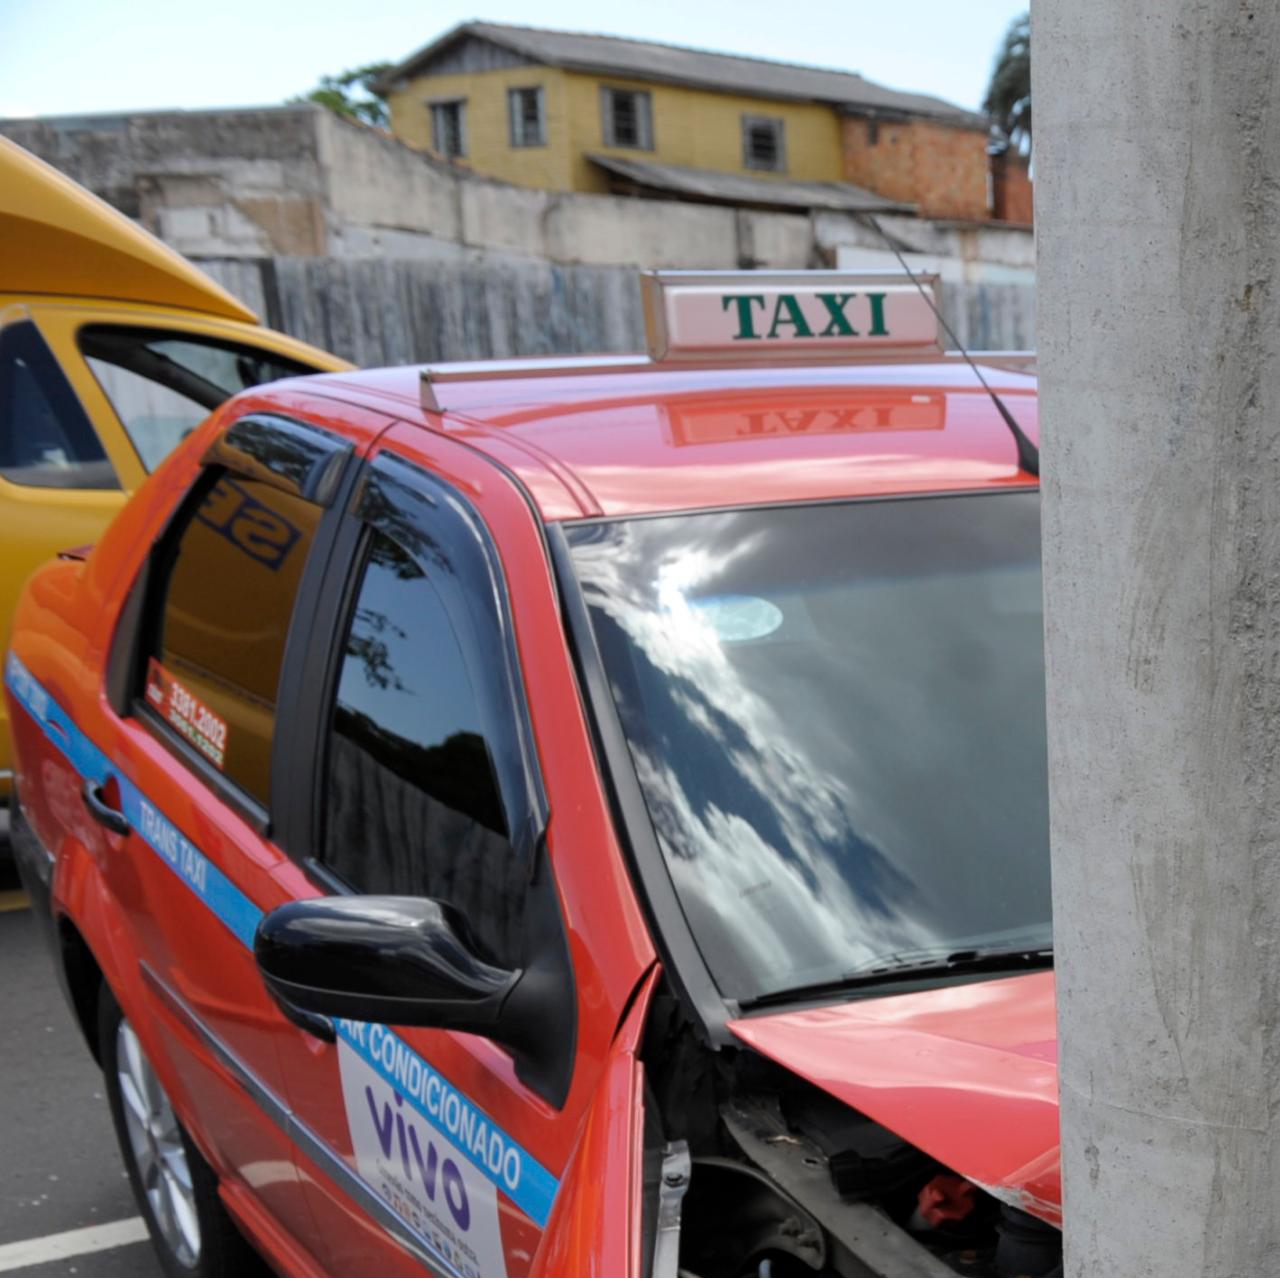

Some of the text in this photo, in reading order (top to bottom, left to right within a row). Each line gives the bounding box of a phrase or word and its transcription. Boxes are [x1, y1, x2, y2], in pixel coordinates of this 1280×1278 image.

[722, 292, 890, 340] TAXI
[178, 835, 207, 892] TAXI
[340, 1018, 522, 1191] AR CONDICIONADO
